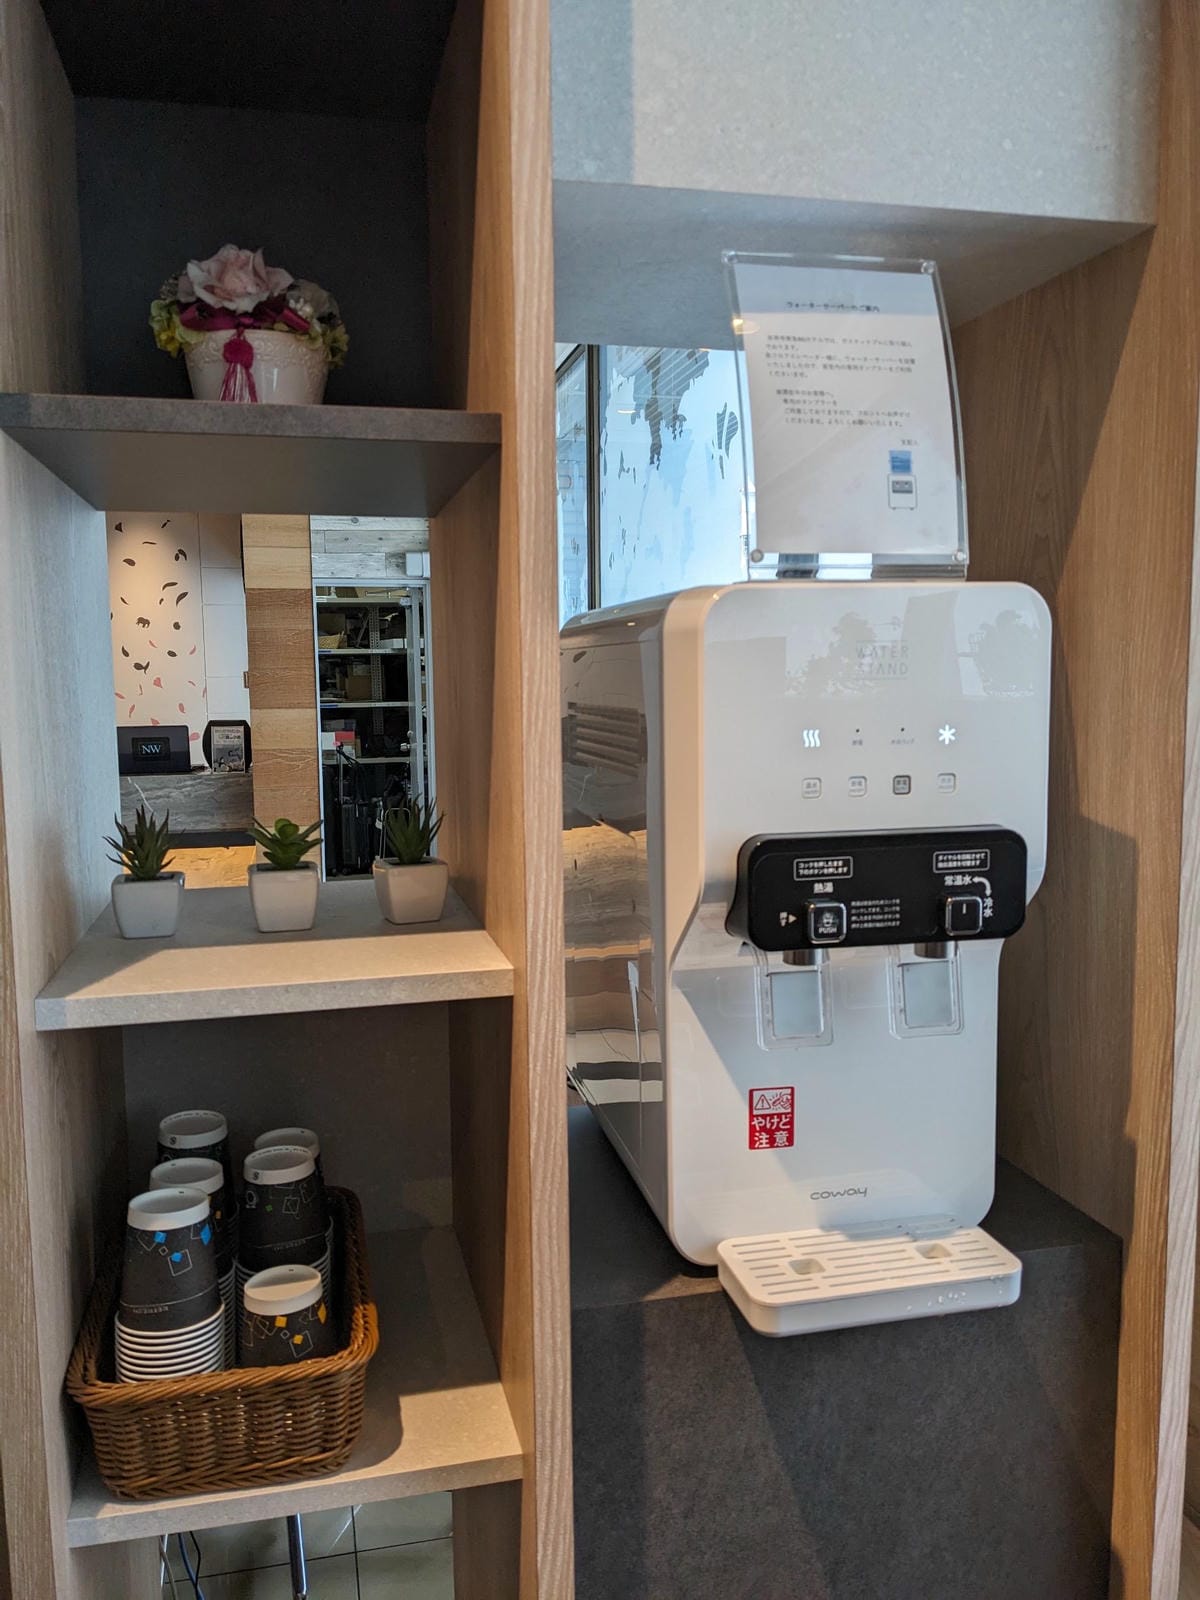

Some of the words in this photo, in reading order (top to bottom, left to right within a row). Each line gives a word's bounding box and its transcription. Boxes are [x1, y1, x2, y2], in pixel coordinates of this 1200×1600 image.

[856, 645, 910, 659] WATER
[857, 663, 910, 675] STAND
[141, 744, 161, 754] NW
[983, 897, 994, 918] 冷水
[752, 1114, 792, 1131] やけど
[754, 1131, 789, 1148] 注意
[810, 1187, 868, 1200] coway
